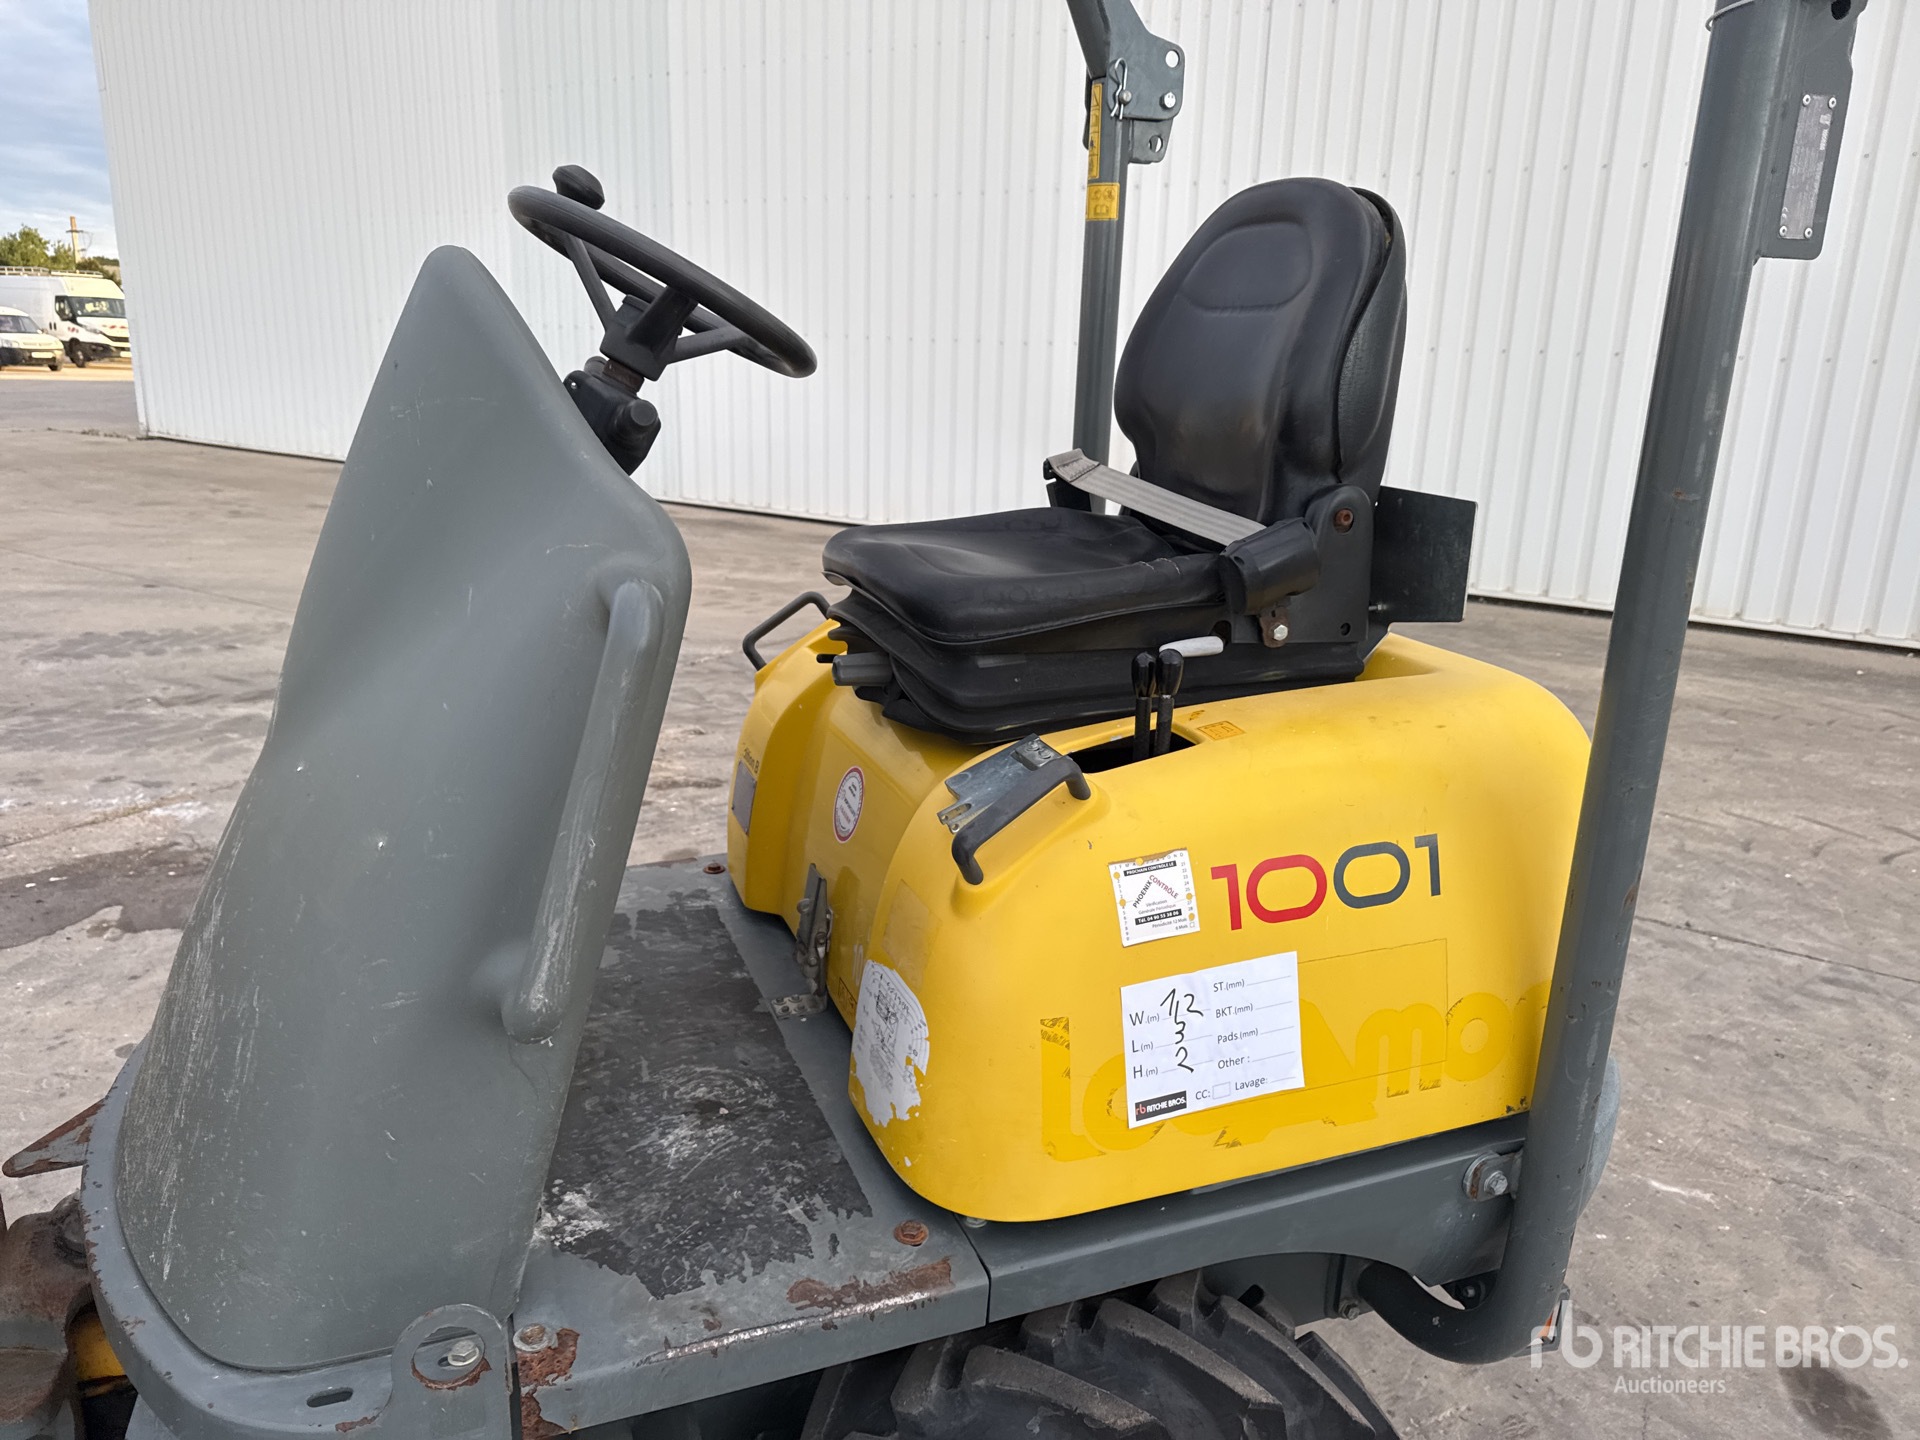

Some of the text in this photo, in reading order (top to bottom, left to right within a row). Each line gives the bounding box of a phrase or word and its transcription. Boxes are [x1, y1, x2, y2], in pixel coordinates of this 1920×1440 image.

[1126, 867, 1148, 875] PROCHAIN
[1210, 834, 1441, 931] 1001
[1132, 880, 1152, 908] PHOENIX
[1149, 875, 1179, 899] CONTRÔLE
[1175, 1046, 1194, 1073] 2
[1146, 1102, 1168, 1112] RITCHIE
[1168, 1096, 1186, 1108] BROS.
[1195, 1089, 1210, 1100] CC:
